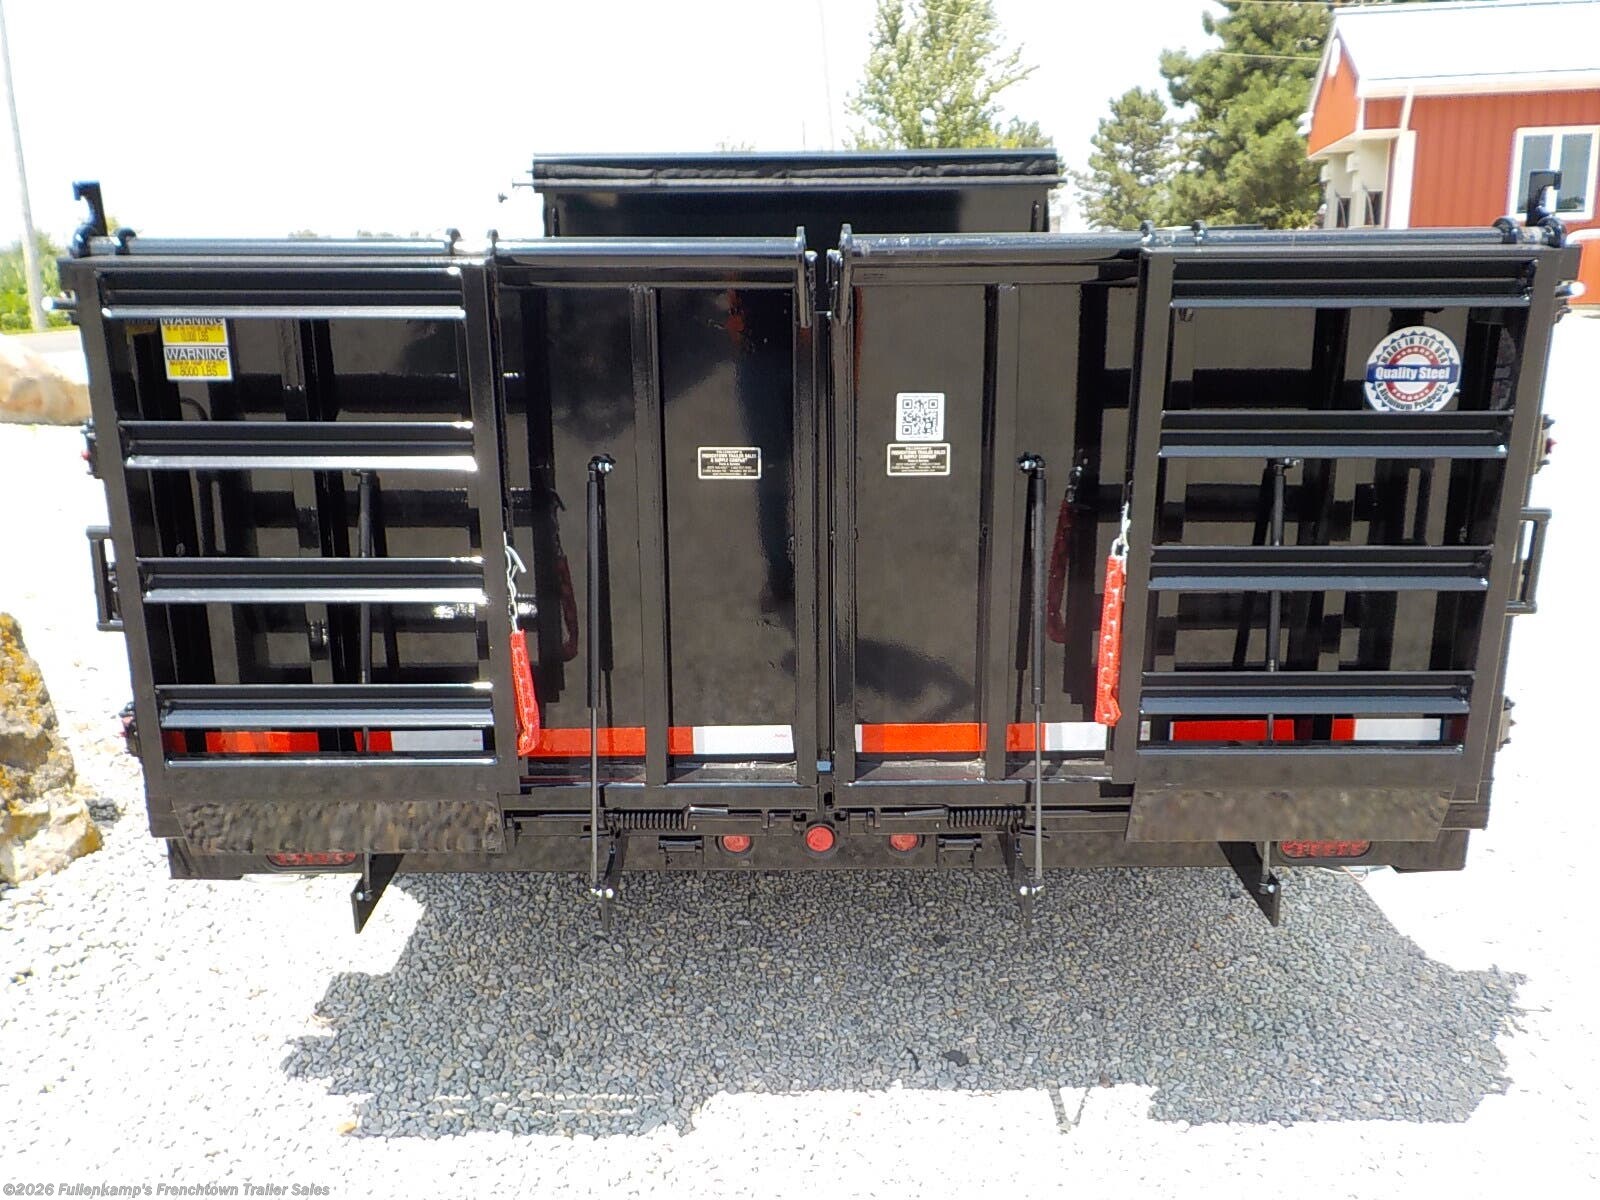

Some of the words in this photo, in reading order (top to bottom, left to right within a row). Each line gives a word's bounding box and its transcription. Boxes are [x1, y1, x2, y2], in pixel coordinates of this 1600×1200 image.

[167, 348, 228, 360] WARNING
[1380, 343, 1402, 363] MADE
[1405, 338, 1415, 346] IN
[1419, 337, 1433, 348] THE
[1435, 346, 1448, 363] USA
[202, 365, 218, 376] LBS
[1375, 366, 1419, 380] Quality
[1419, 366, 1451, 380] Steel
[1379, 388, 1413, 410] Aluminum
[1414, 384, 1445, 410] Products
